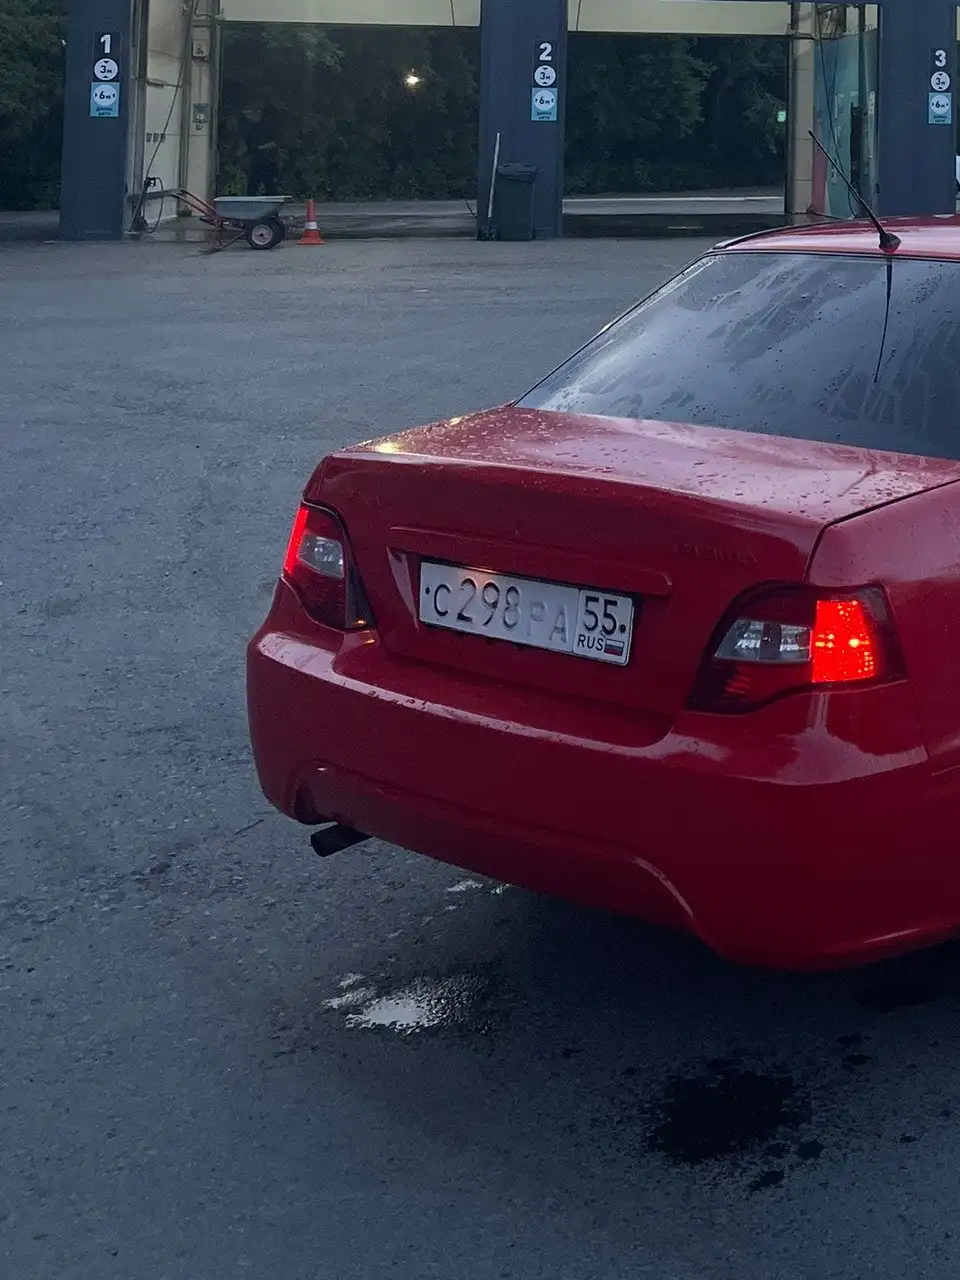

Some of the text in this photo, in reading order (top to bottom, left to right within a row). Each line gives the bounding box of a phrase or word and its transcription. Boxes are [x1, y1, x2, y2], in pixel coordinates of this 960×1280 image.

[100, 34, 111, 54] 1
[539, 42, 552, 61] 2
[934, 49, 947, 67] 3
[584, 595, 618, 636] 55
[577, 633, 605, 652] RUS
